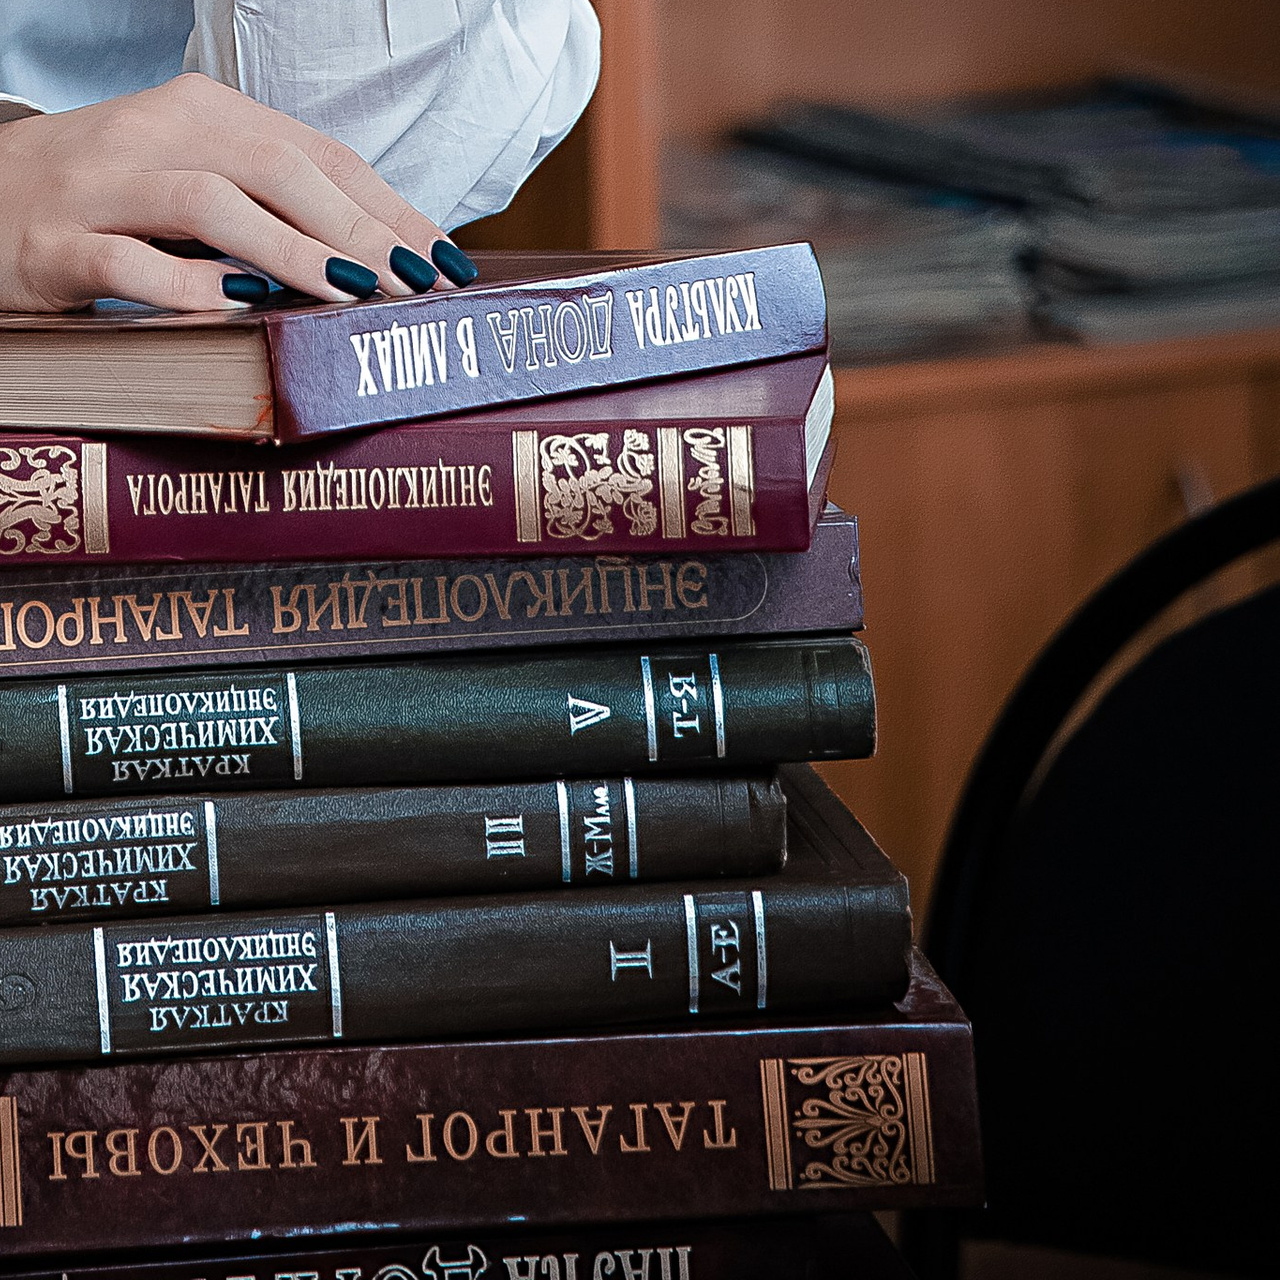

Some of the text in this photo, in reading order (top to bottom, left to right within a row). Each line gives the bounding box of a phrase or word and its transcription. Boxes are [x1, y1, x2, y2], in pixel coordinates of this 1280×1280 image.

[349, 272, 763, 396] КУЛЬТУРА ДОНА В ЛИЦАХ
[126, 459, 493, 516] ЭНЦИКЛОПЕДИЯ ТАГАНРОГА
[272, 557, 708, 634] ЭНЦИКЛОПЕДИЯ
[80, 687, 277, 719] ЭНЦИКЛОПЕДИЯ
[567, 693, 610, 736] V
[85, 715, 278, 755] ХИМИЧЕСКАЯ
[111, 753, 251, 781] КРАТКАЯ
[3, 842, 197, 884] ХИМИЧЕСКАЯ
[31, 880, 168, 911] КРАТКАЯ
[117, 931, 317, 966] ЭНЦИКЛОПЕДИЯ
[120, 964, 317, 1002] ХИМИЧЕСКАЯ
[149, 1001, 288, 1031] КРАТКАЯ
[46, 1099, 736, 1180] ТАГАНРОГ И ЧЕХОВЫ
